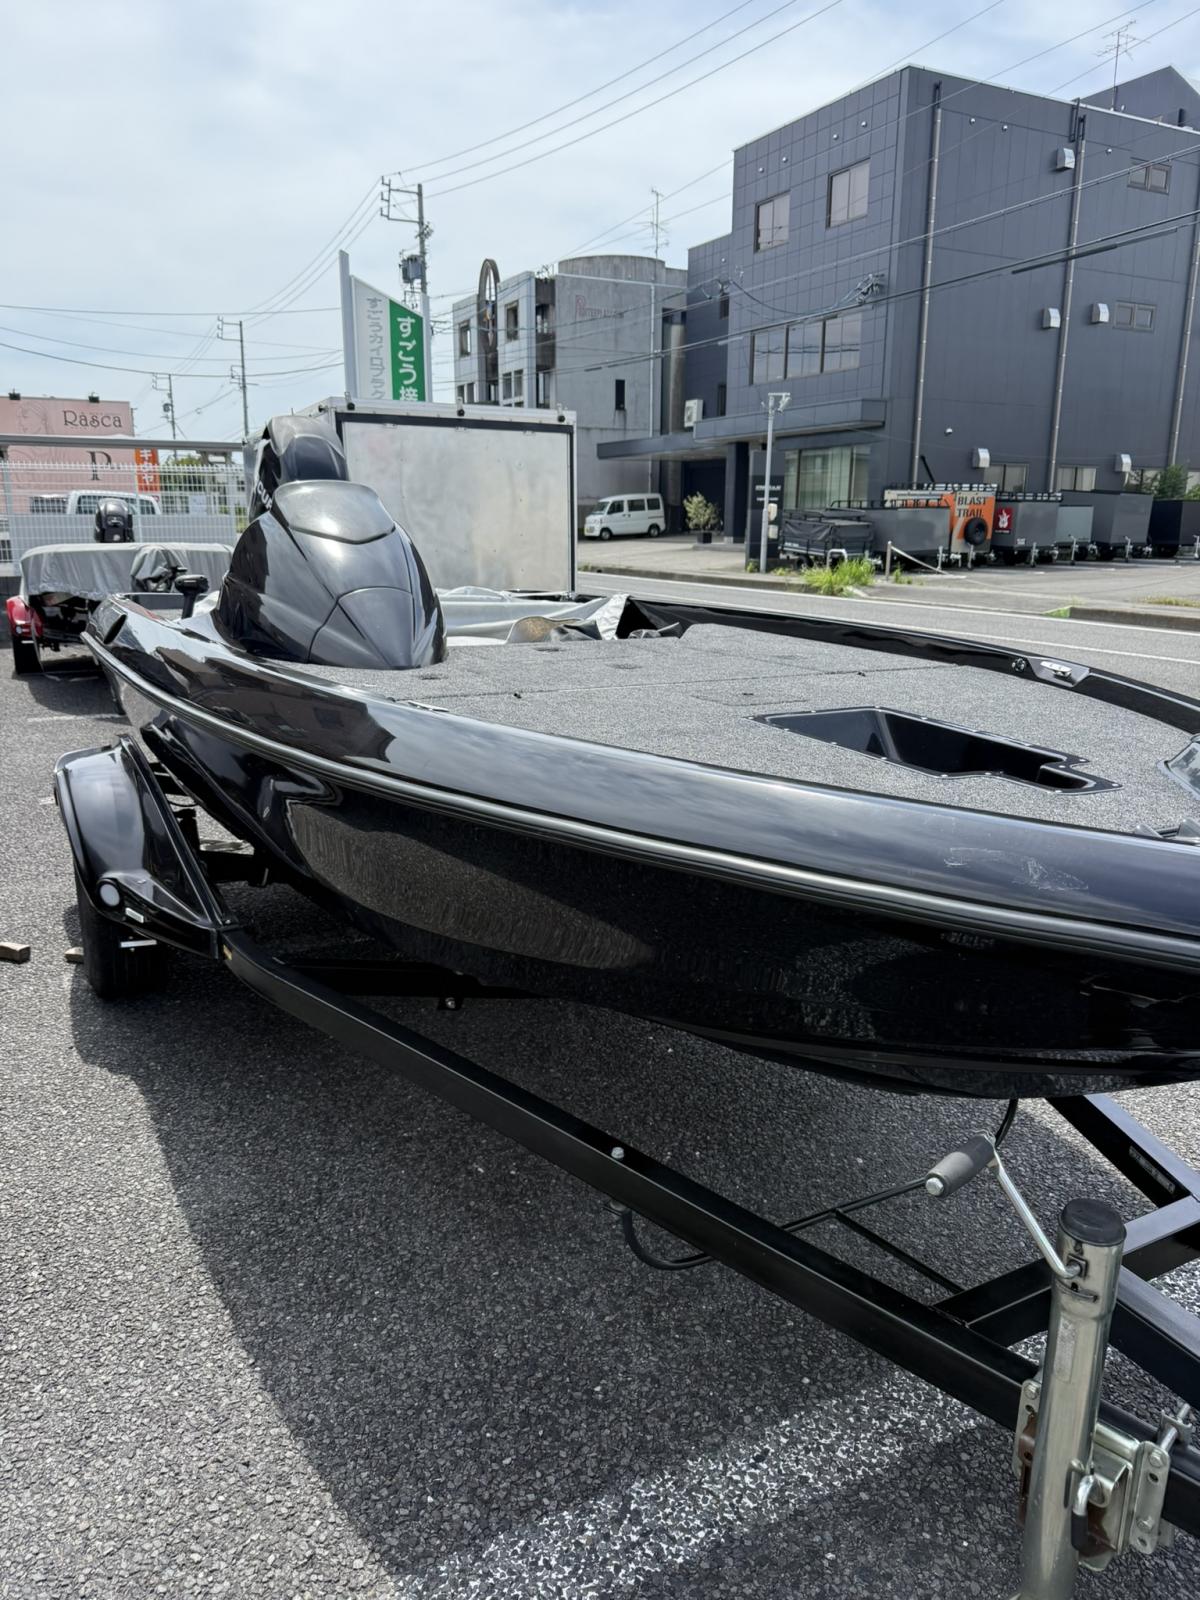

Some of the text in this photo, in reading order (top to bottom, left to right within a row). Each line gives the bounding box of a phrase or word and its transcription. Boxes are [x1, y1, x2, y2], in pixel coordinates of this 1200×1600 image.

[62, 410, 122, 428] Rasca
[86, 450, 112, 481] P
[957, 496, 986, 506] BLAST
[957, 508, 984, 518] TRAIL
